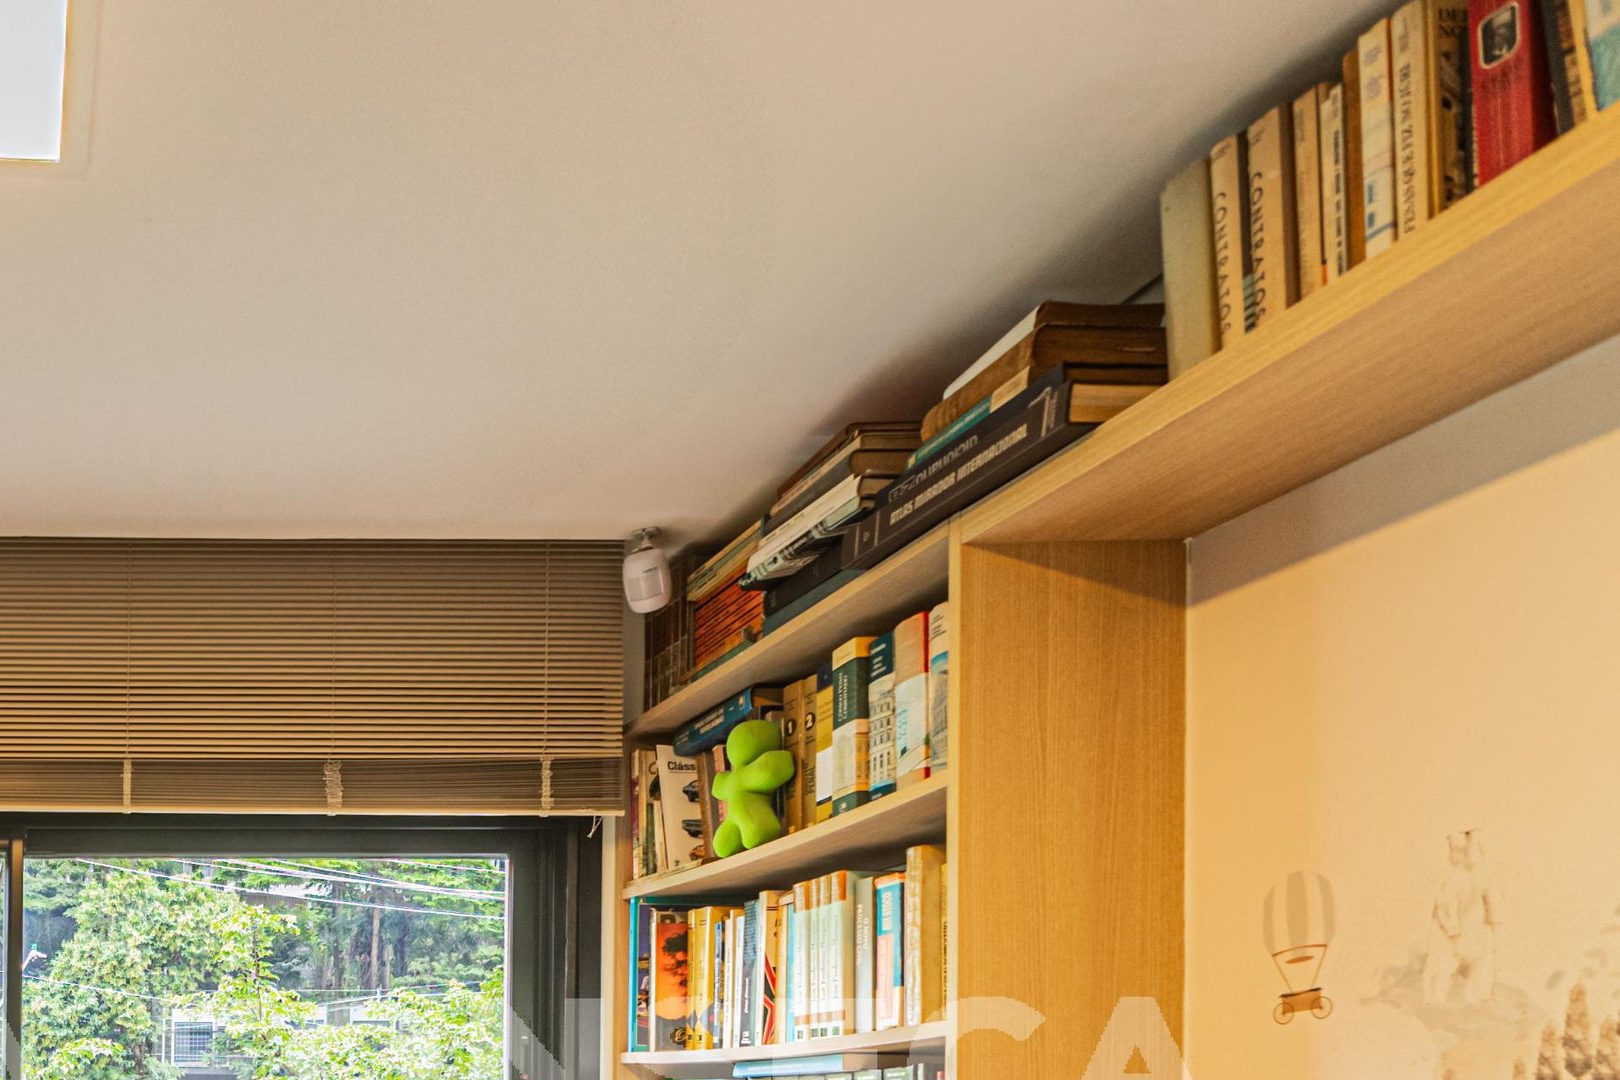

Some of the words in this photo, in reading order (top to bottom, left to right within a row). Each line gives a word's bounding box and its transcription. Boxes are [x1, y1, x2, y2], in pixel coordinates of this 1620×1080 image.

[1212, 191, 1232, 337] CONTRATOS
[1251, 171, 1268, 326] CONTRATOS
[1401, 185, 1416, 234] FESAS
[889, 496, 914, 527] ATLAS
[956, 423, 1028, 481] INTERNACIONAL
